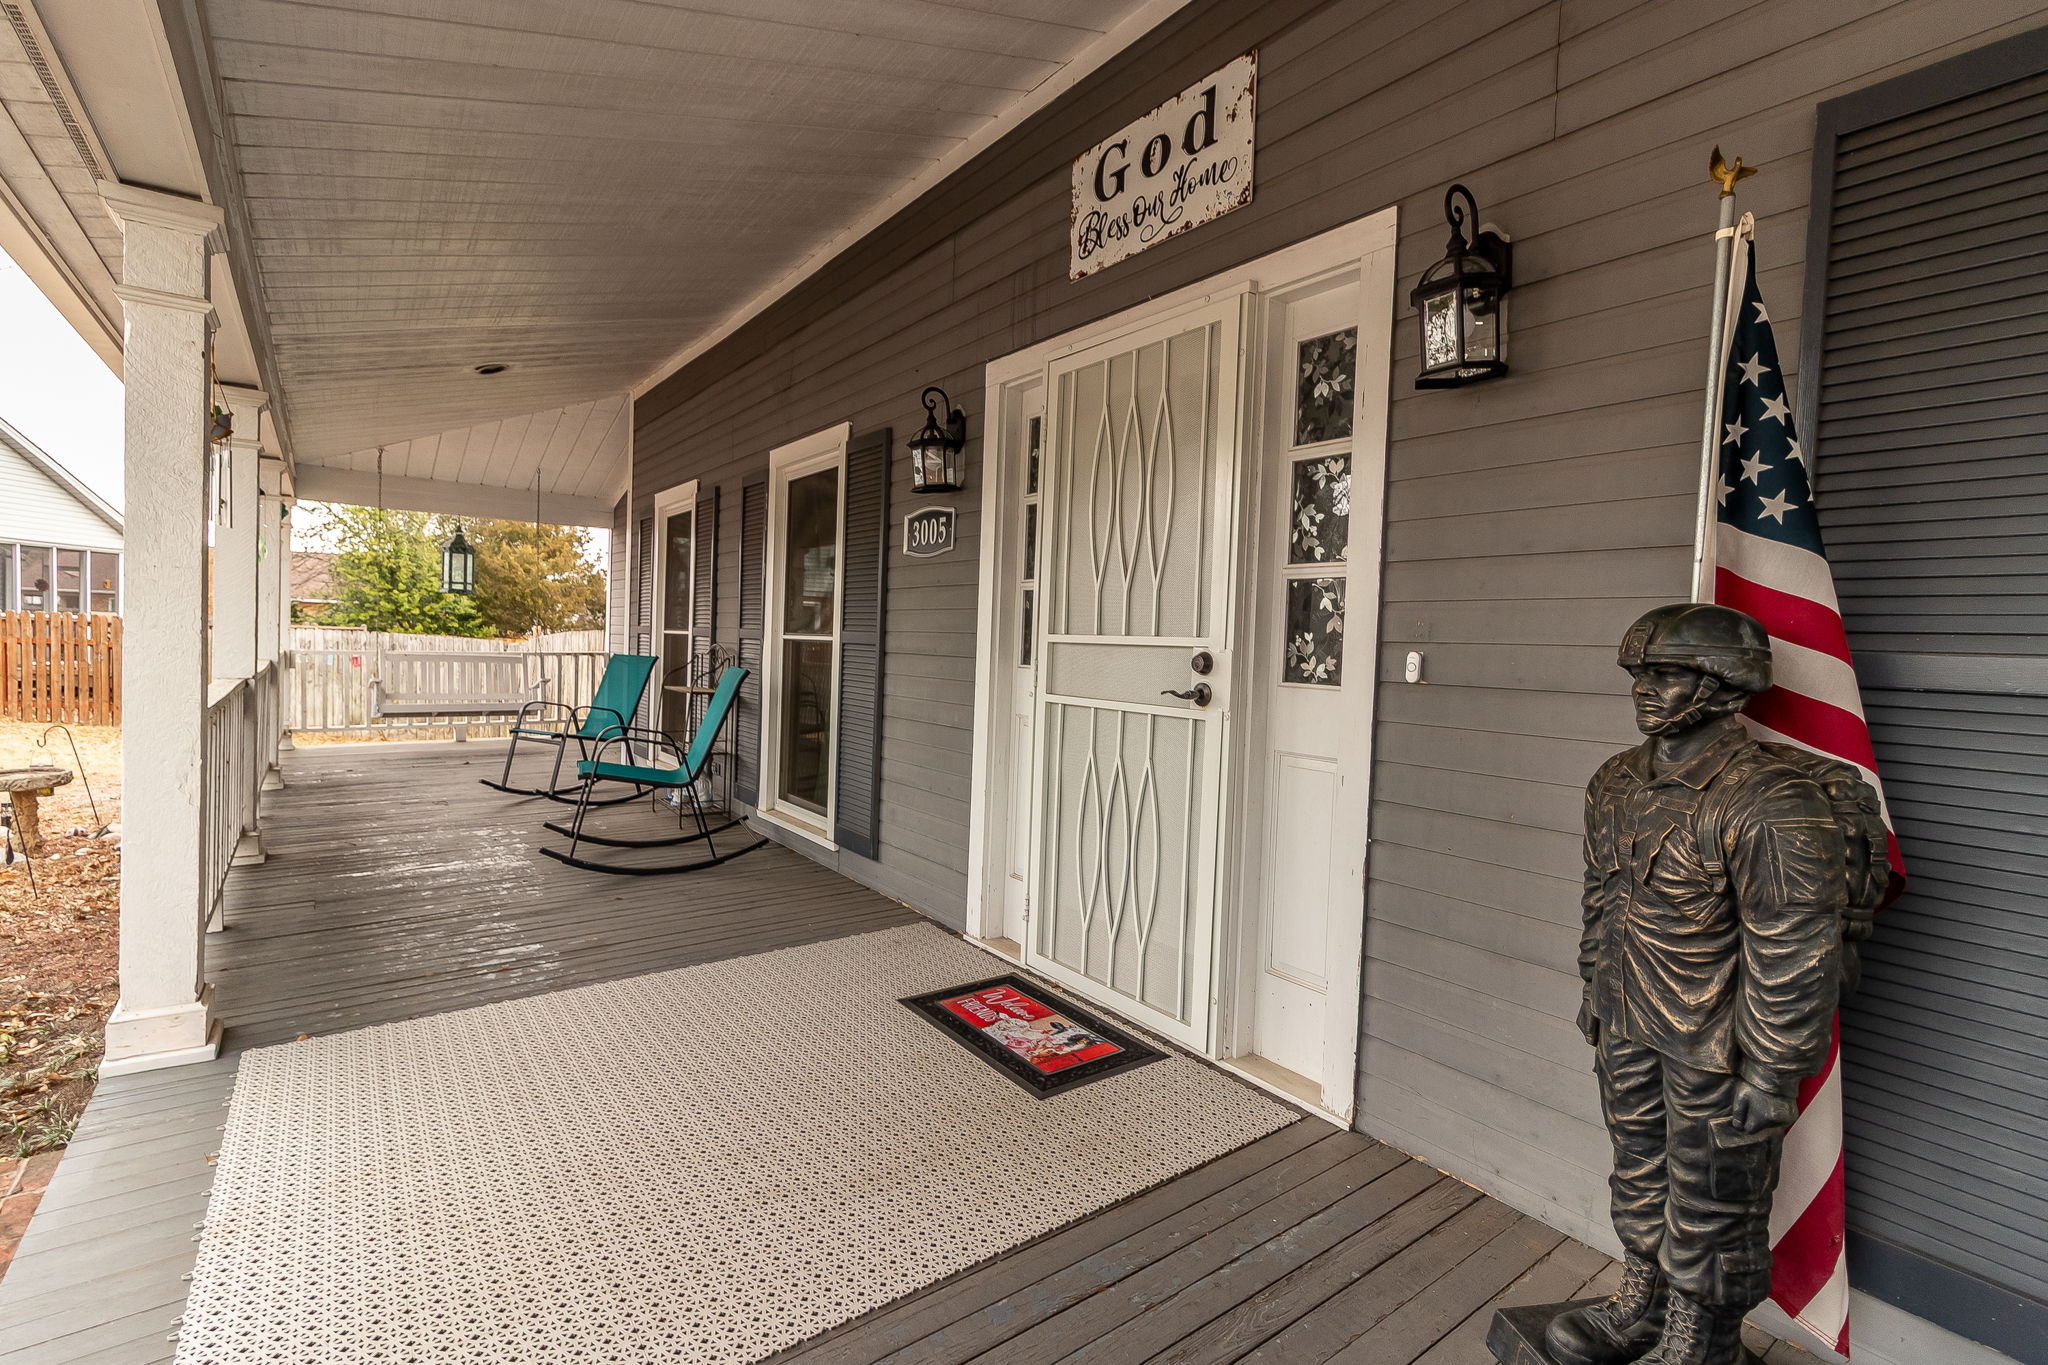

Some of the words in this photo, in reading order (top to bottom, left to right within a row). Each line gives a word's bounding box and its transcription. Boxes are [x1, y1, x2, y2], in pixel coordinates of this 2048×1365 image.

[1093, 84, 1219, 202] God
[1078, 210, 1130, 260] Bless
[1132, 190, 1184, 243] Our
[1169, 156, 1238, 207] Home
[912, 516, 947, 547] 3005
